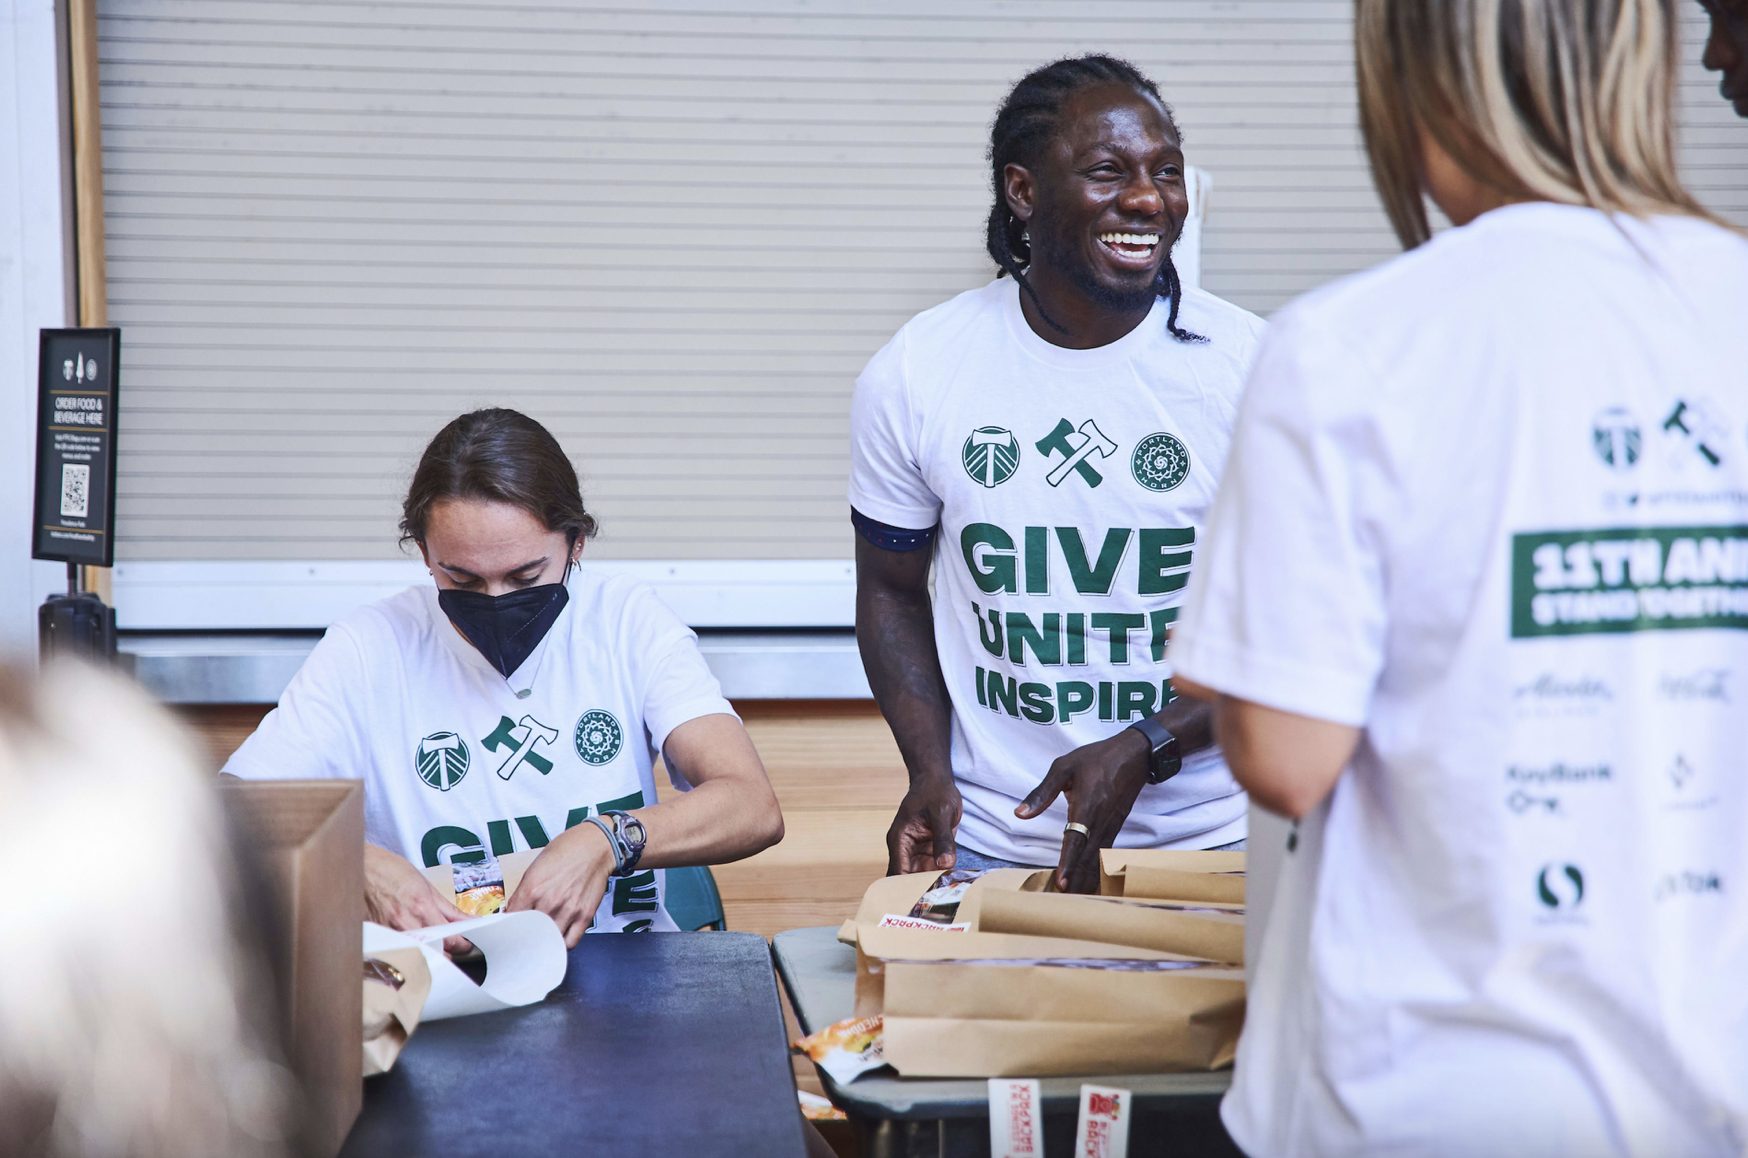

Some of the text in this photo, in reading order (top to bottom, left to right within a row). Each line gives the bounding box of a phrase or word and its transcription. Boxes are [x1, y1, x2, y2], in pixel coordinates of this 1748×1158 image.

[55, 397, 103, 411] ORDER FOOD &
[53, 411, 103, 425] BEVERAGE HERE
[1137, 436, 1186, 458] PORTLAND
[1137, 469, 1185, 489] THORNS
[960, 522, 1196, 597] GIVE
[577, 713, 616, 735] PORTLAND
